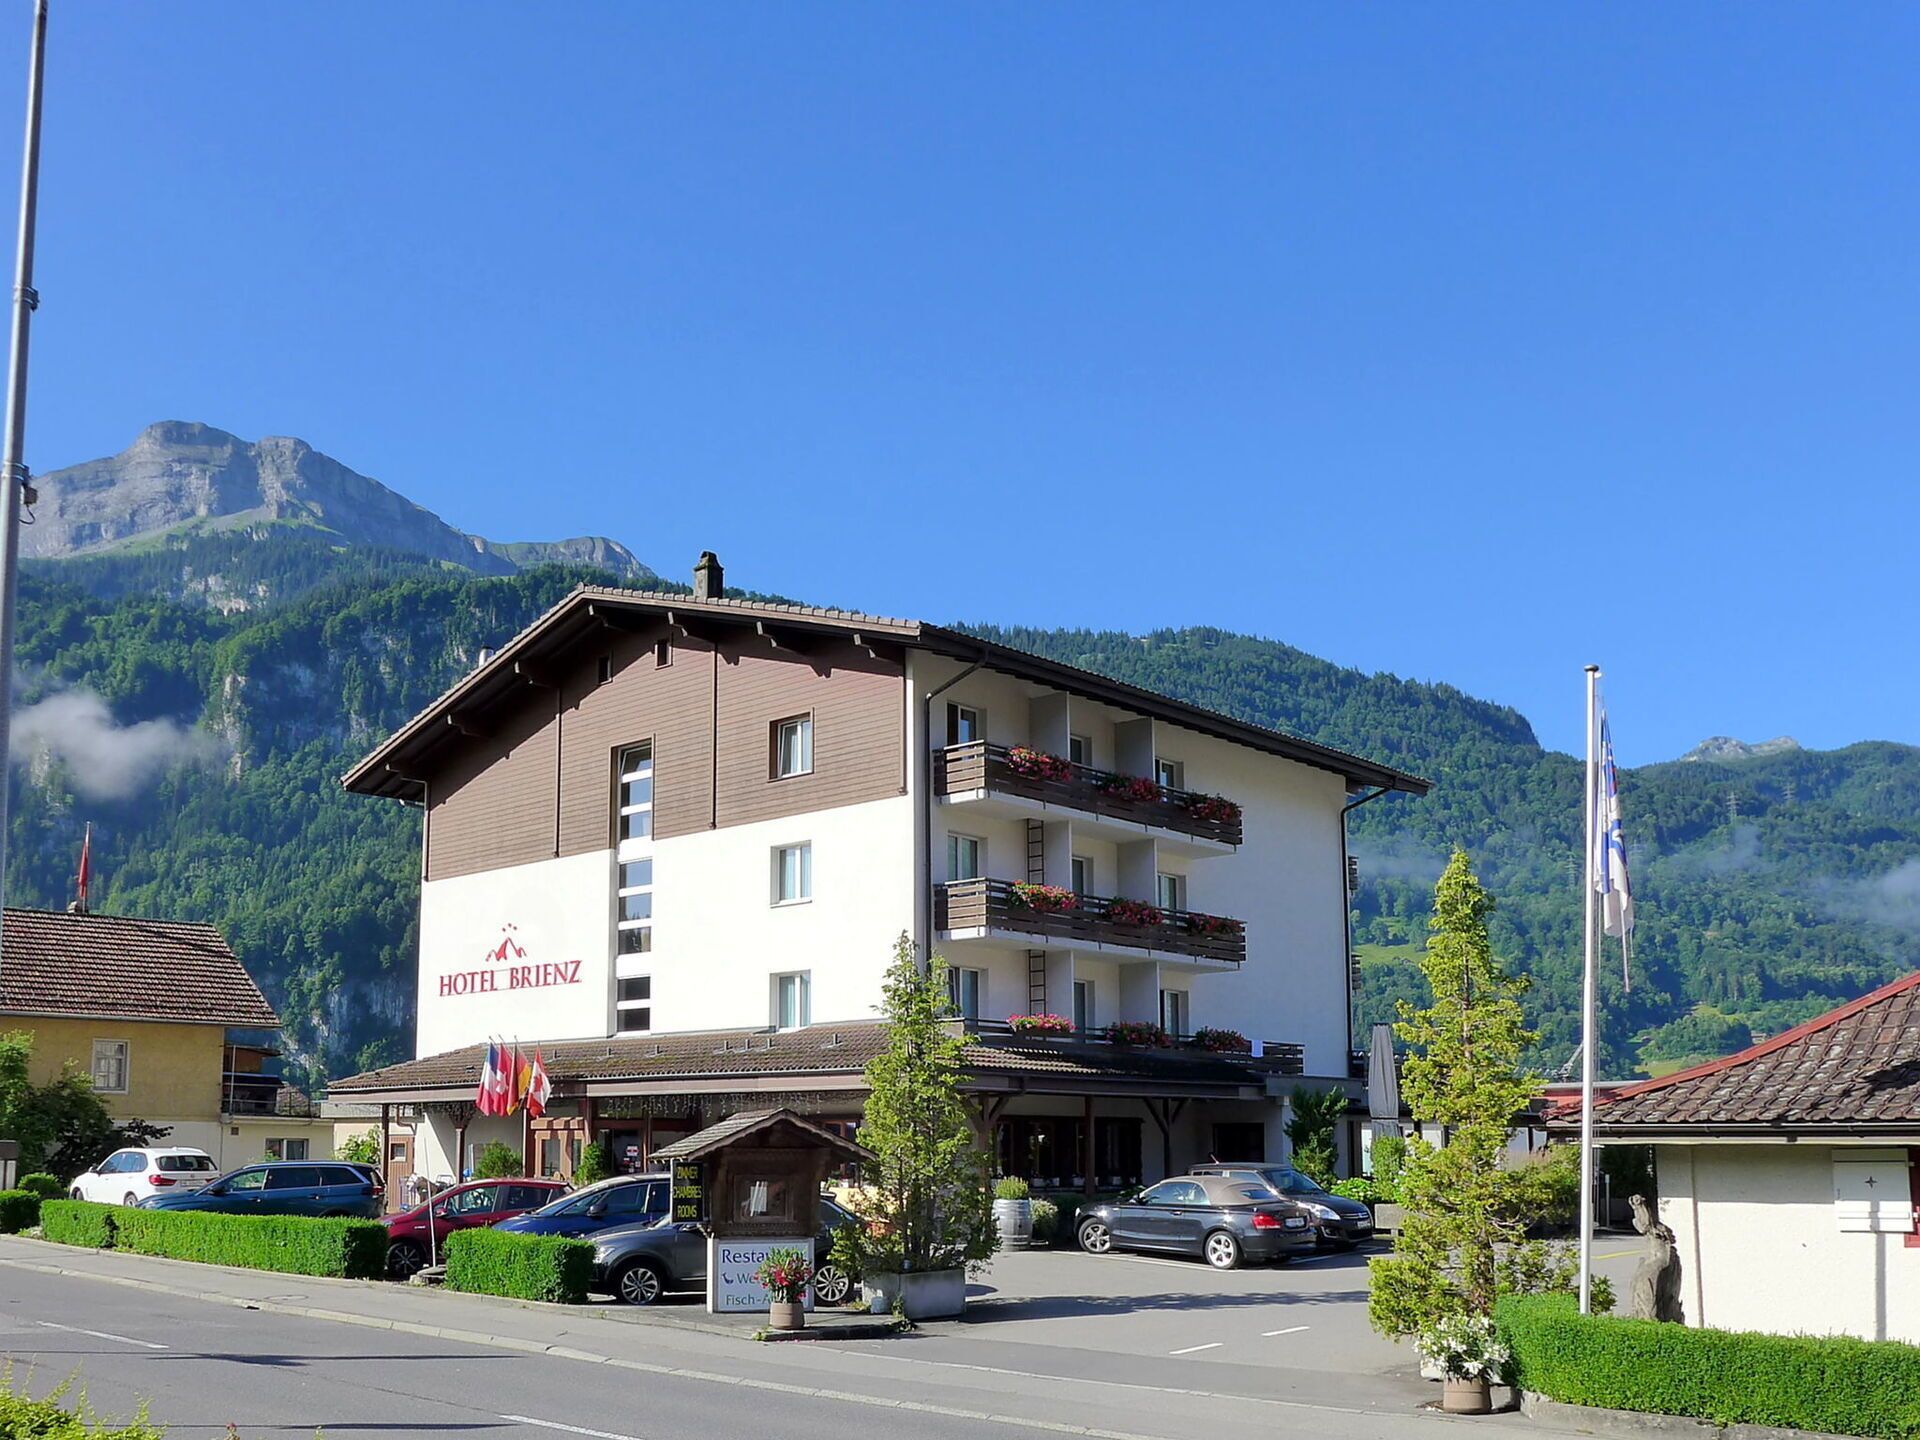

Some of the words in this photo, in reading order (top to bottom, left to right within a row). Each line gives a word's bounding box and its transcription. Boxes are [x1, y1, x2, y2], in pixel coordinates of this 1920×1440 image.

[439, 969, 498, 997] HOTEL
[510, 959, 582, 990] BRIENZ
[677, 1204, 698, 1218] ROOMS
